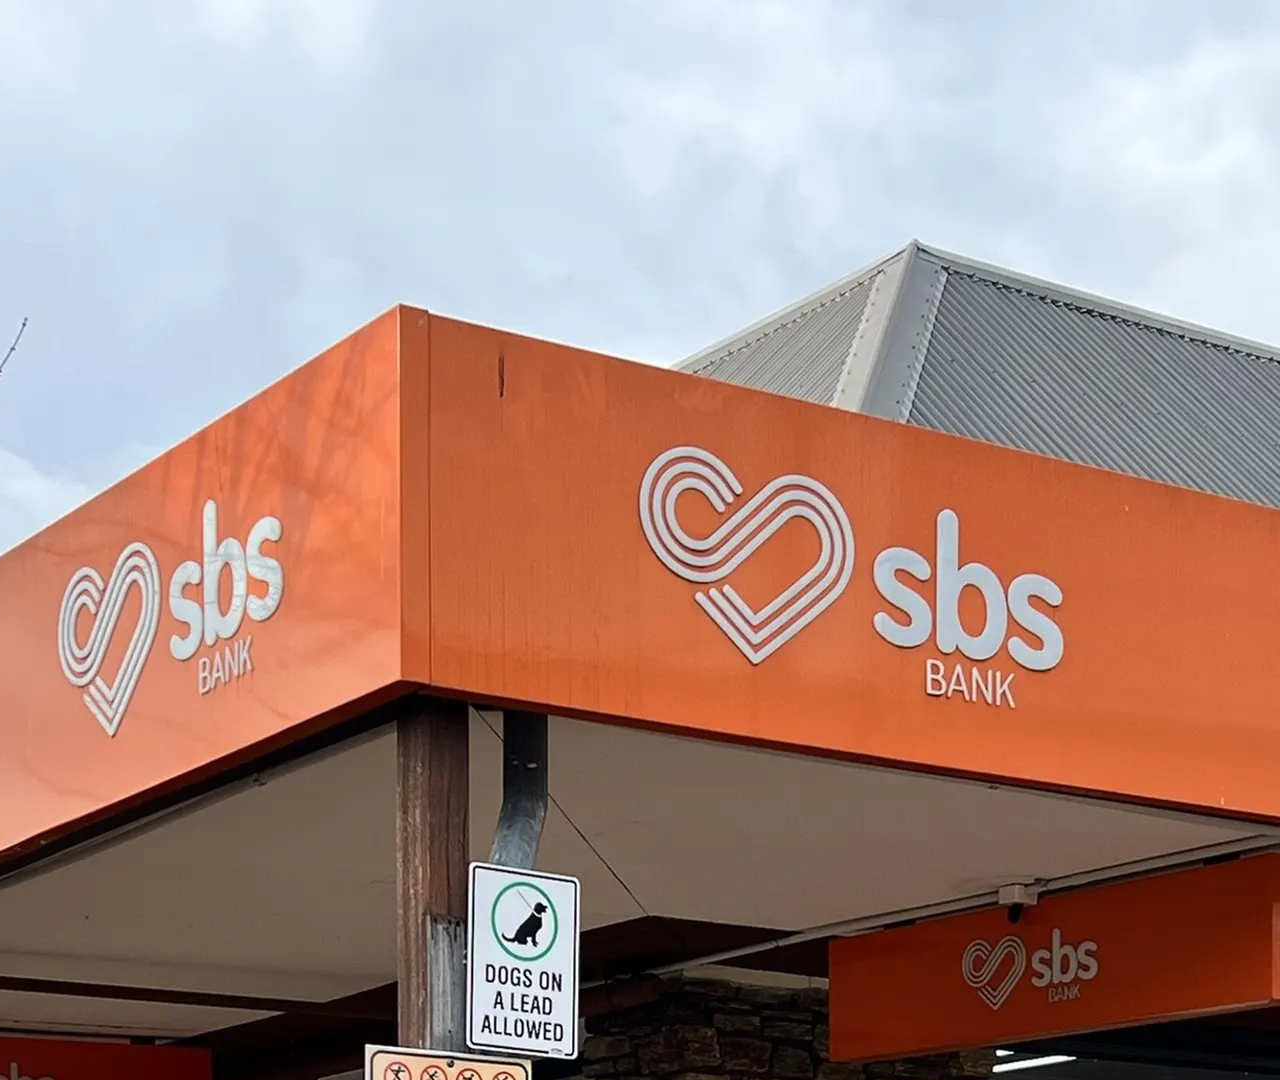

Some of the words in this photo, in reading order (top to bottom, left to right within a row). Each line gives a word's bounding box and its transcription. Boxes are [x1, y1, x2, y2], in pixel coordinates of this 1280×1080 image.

[170, 499, 284, 661] sbs
[873, 508, 1064, 671] sbs
[198, 635, 254, 695] BANK
[925, 658, 1016, 709] BANK
[485, 963, 533, 988] DOGS
[539, 971, 562, 992] ON
[1031, 928, 1099, 988] sbs
[493, 990, 504, 1010] A
[510, 992, 552, 1016] LEAD
[1048, 983, 1081, 1003] BANK
[481, 1014, 563, 1042] ALLOWED
